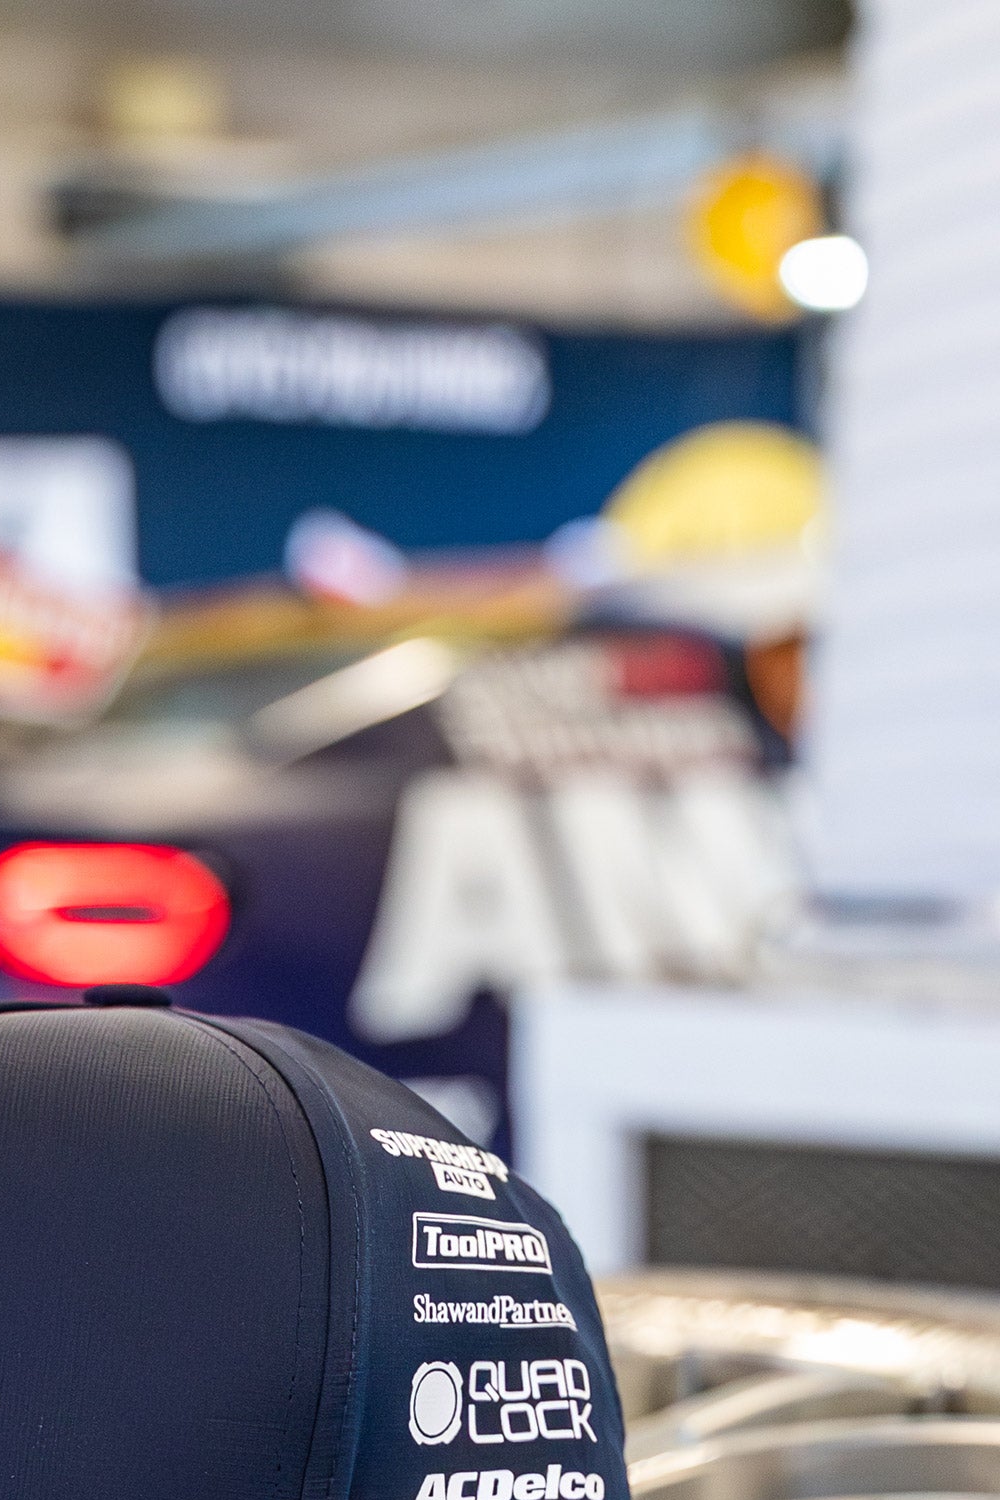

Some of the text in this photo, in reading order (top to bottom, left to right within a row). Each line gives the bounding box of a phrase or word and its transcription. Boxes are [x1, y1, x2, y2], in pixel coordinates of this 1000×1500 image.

[443, 1171, 485, 1191] AUTO
[468, 1359, 591, 1402] QUAD
[467, 1400, 598, 1444] LOCK
